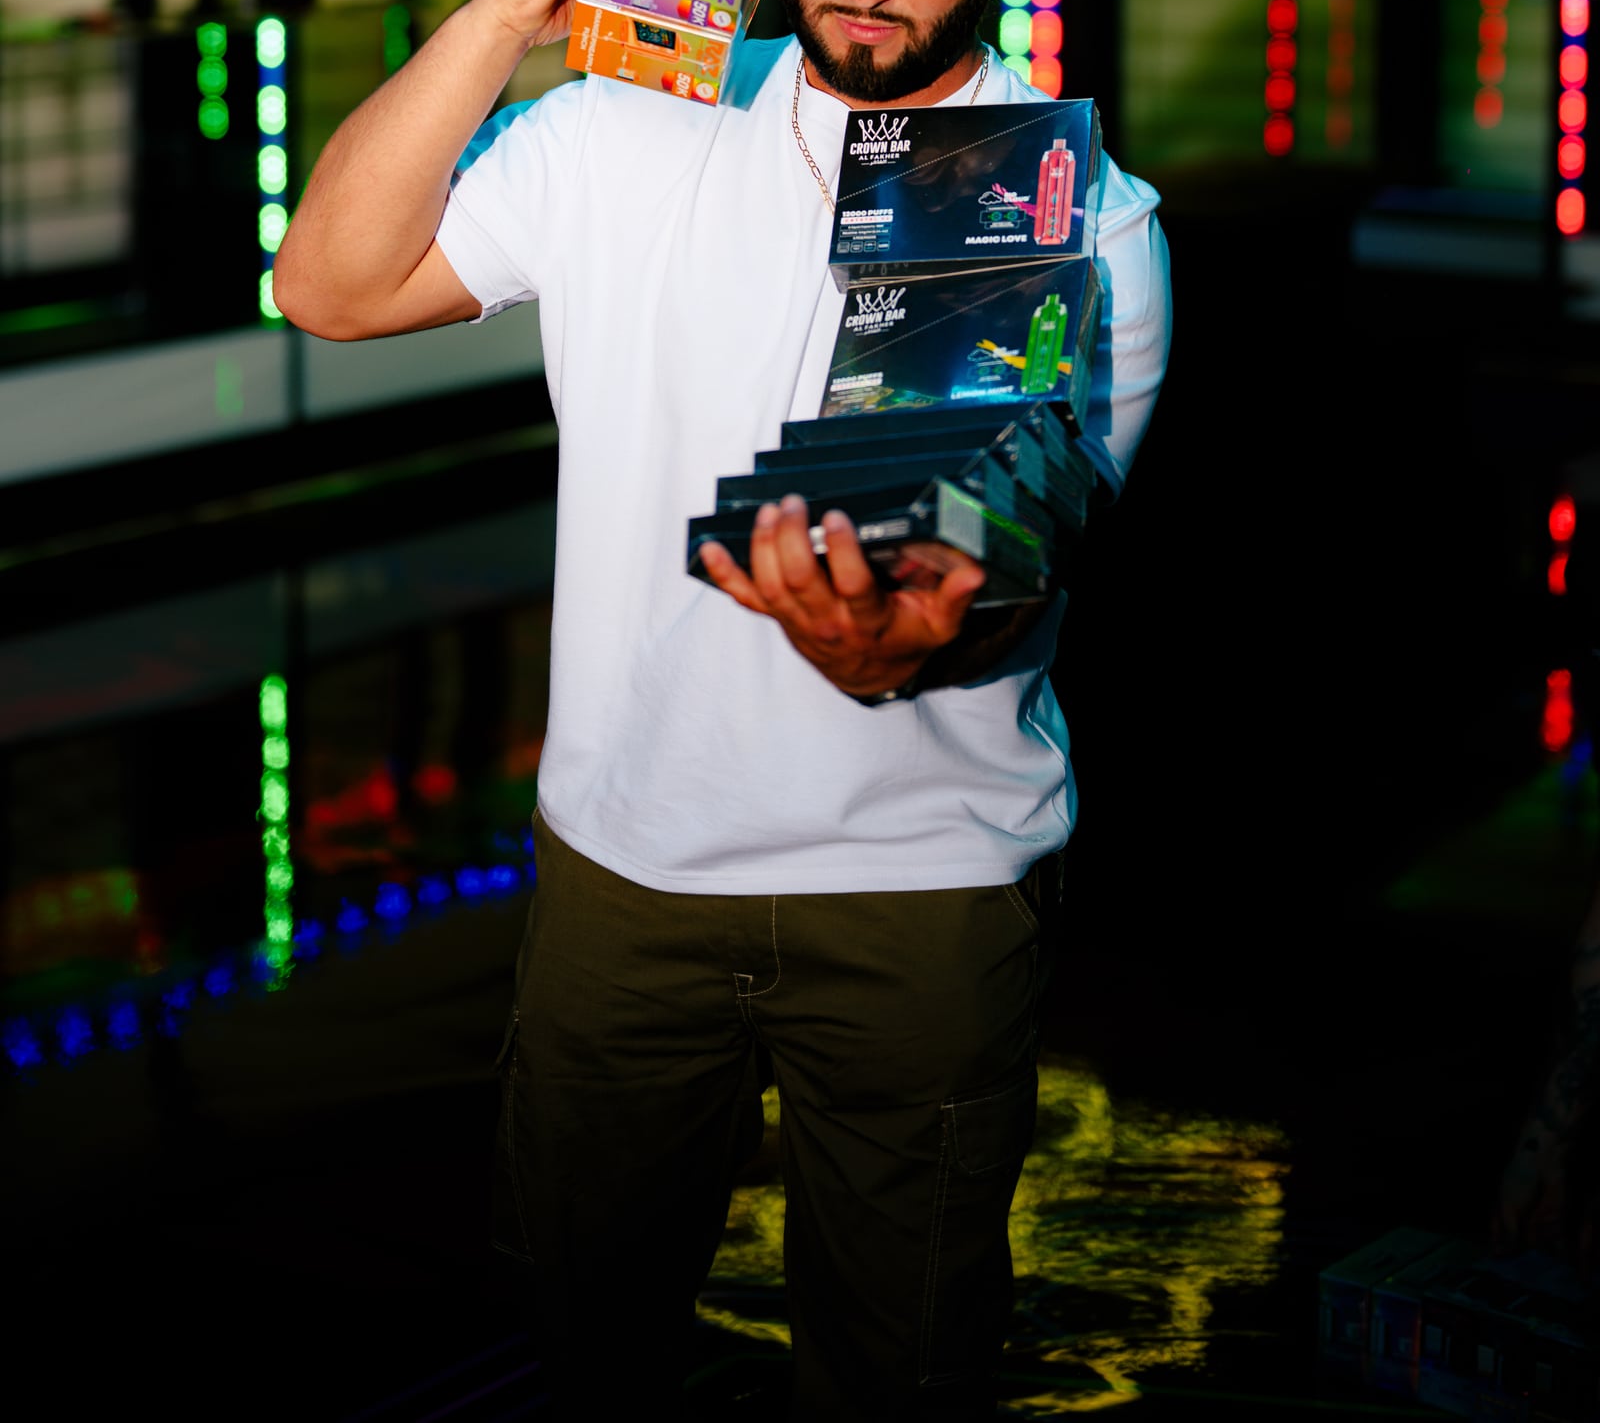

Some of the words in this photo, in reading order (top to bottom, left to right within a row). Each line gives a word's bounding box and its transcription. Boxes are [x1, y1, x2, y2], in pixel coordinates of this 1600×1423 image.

[691, 0, 708, 27] 50K
[700, 39, 725, 78] RAZ
[676, 71, 692, 98] 50K
[850, 141, 888, 155] CROWN
[890, 139, 911, 153] BAR
[868, 208, 894, 216] PUFFS
[965, 235, 1000, 245] MAGIC
[1001, 234, 1028, 243] LOVE
[845, 311, 884, 328] CROWN
[885, 307, 906, 321] BAR
